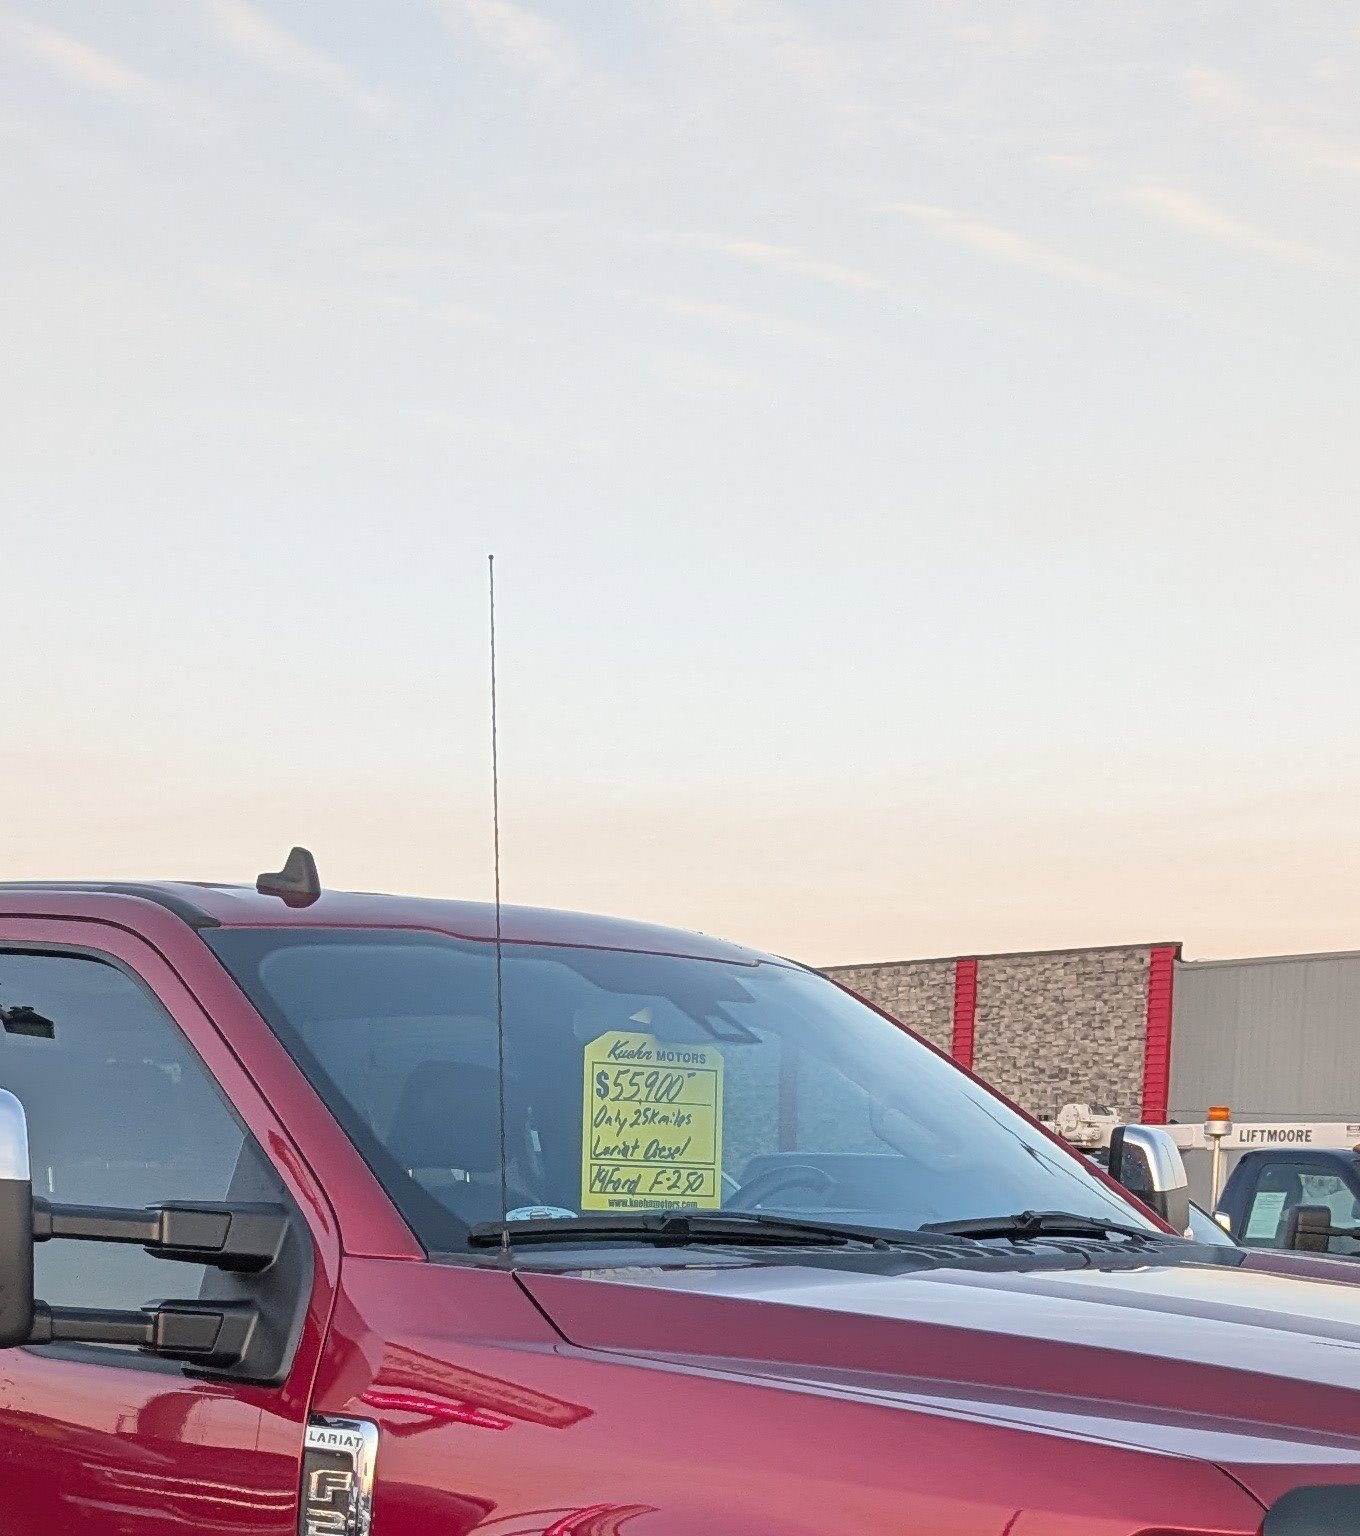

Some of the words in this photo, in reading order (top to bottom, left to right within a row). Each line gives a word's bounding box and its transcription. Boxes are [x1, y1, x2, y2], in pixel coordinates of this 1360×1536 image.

[656, 1050, 706, 1064] MOTORS
[593, 1104, 628, 1137] Only
[1239, 1130, 1313, 1143] LIFTMOORE
[309, 1430, 364, 1449] LARIAT
